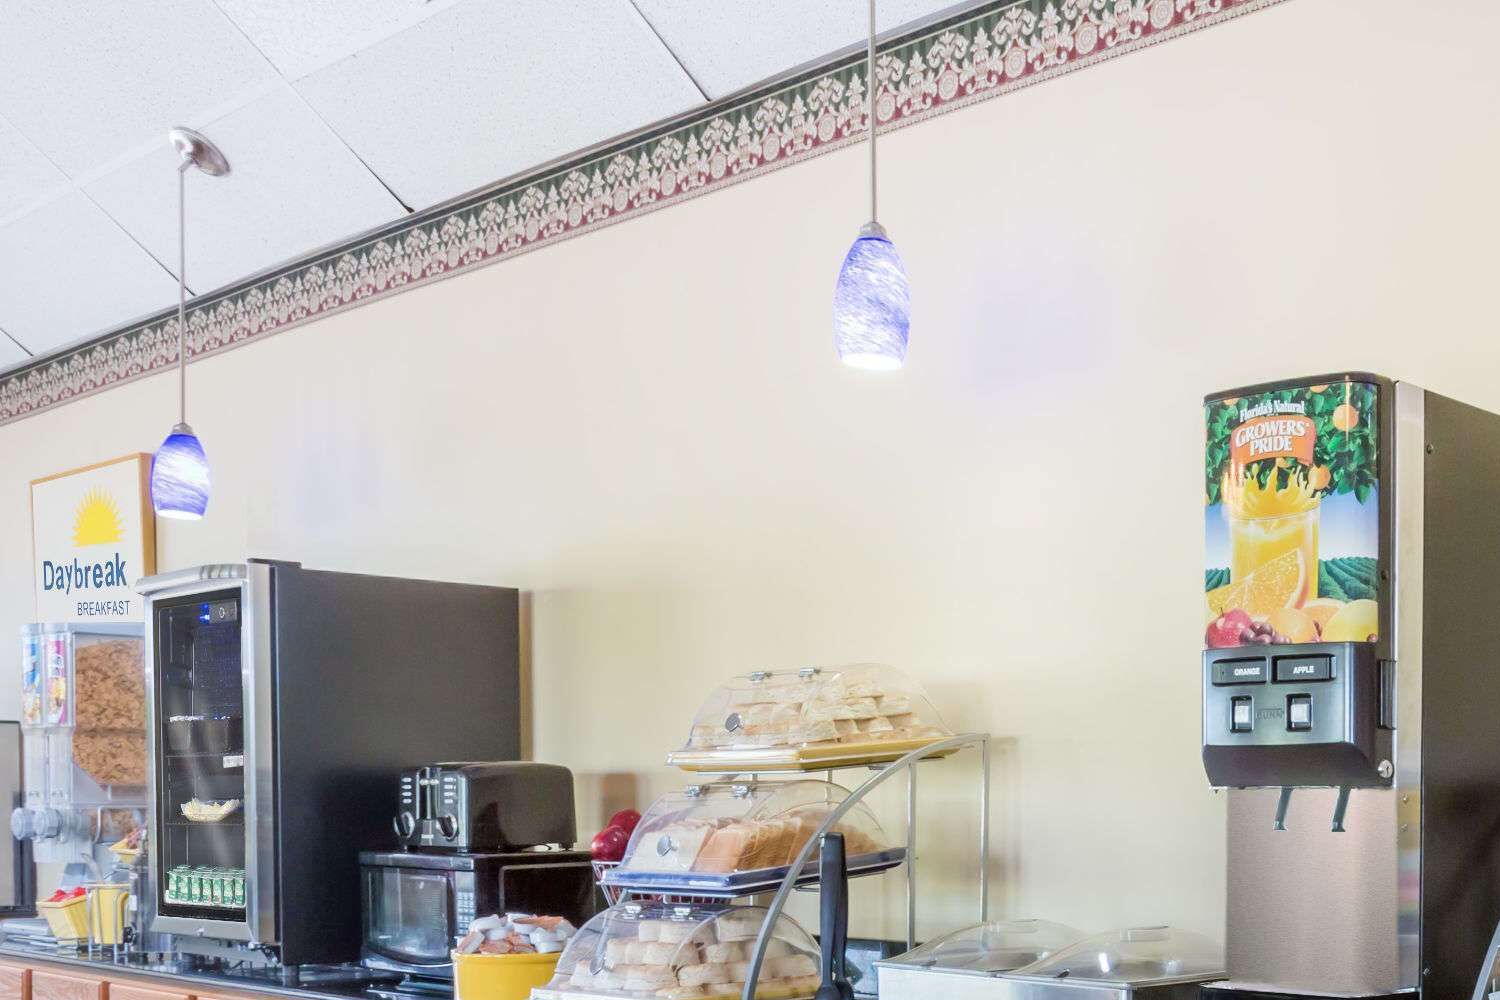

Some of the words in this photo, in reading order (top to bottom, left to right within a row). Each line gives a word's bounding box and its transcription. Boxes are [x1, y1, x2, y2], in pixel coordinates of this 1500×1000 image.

[1273, 399, 1305, 414] Natural
[1249, 436, 1293, 457] PRIDE
[43, 553, 127, 595] Daybreak
[77, 600, 130, 616] BREAKFAST
[1234, 667, 1260, 676] ORANGE
[1293, 665, 1315, 674] APPLE
